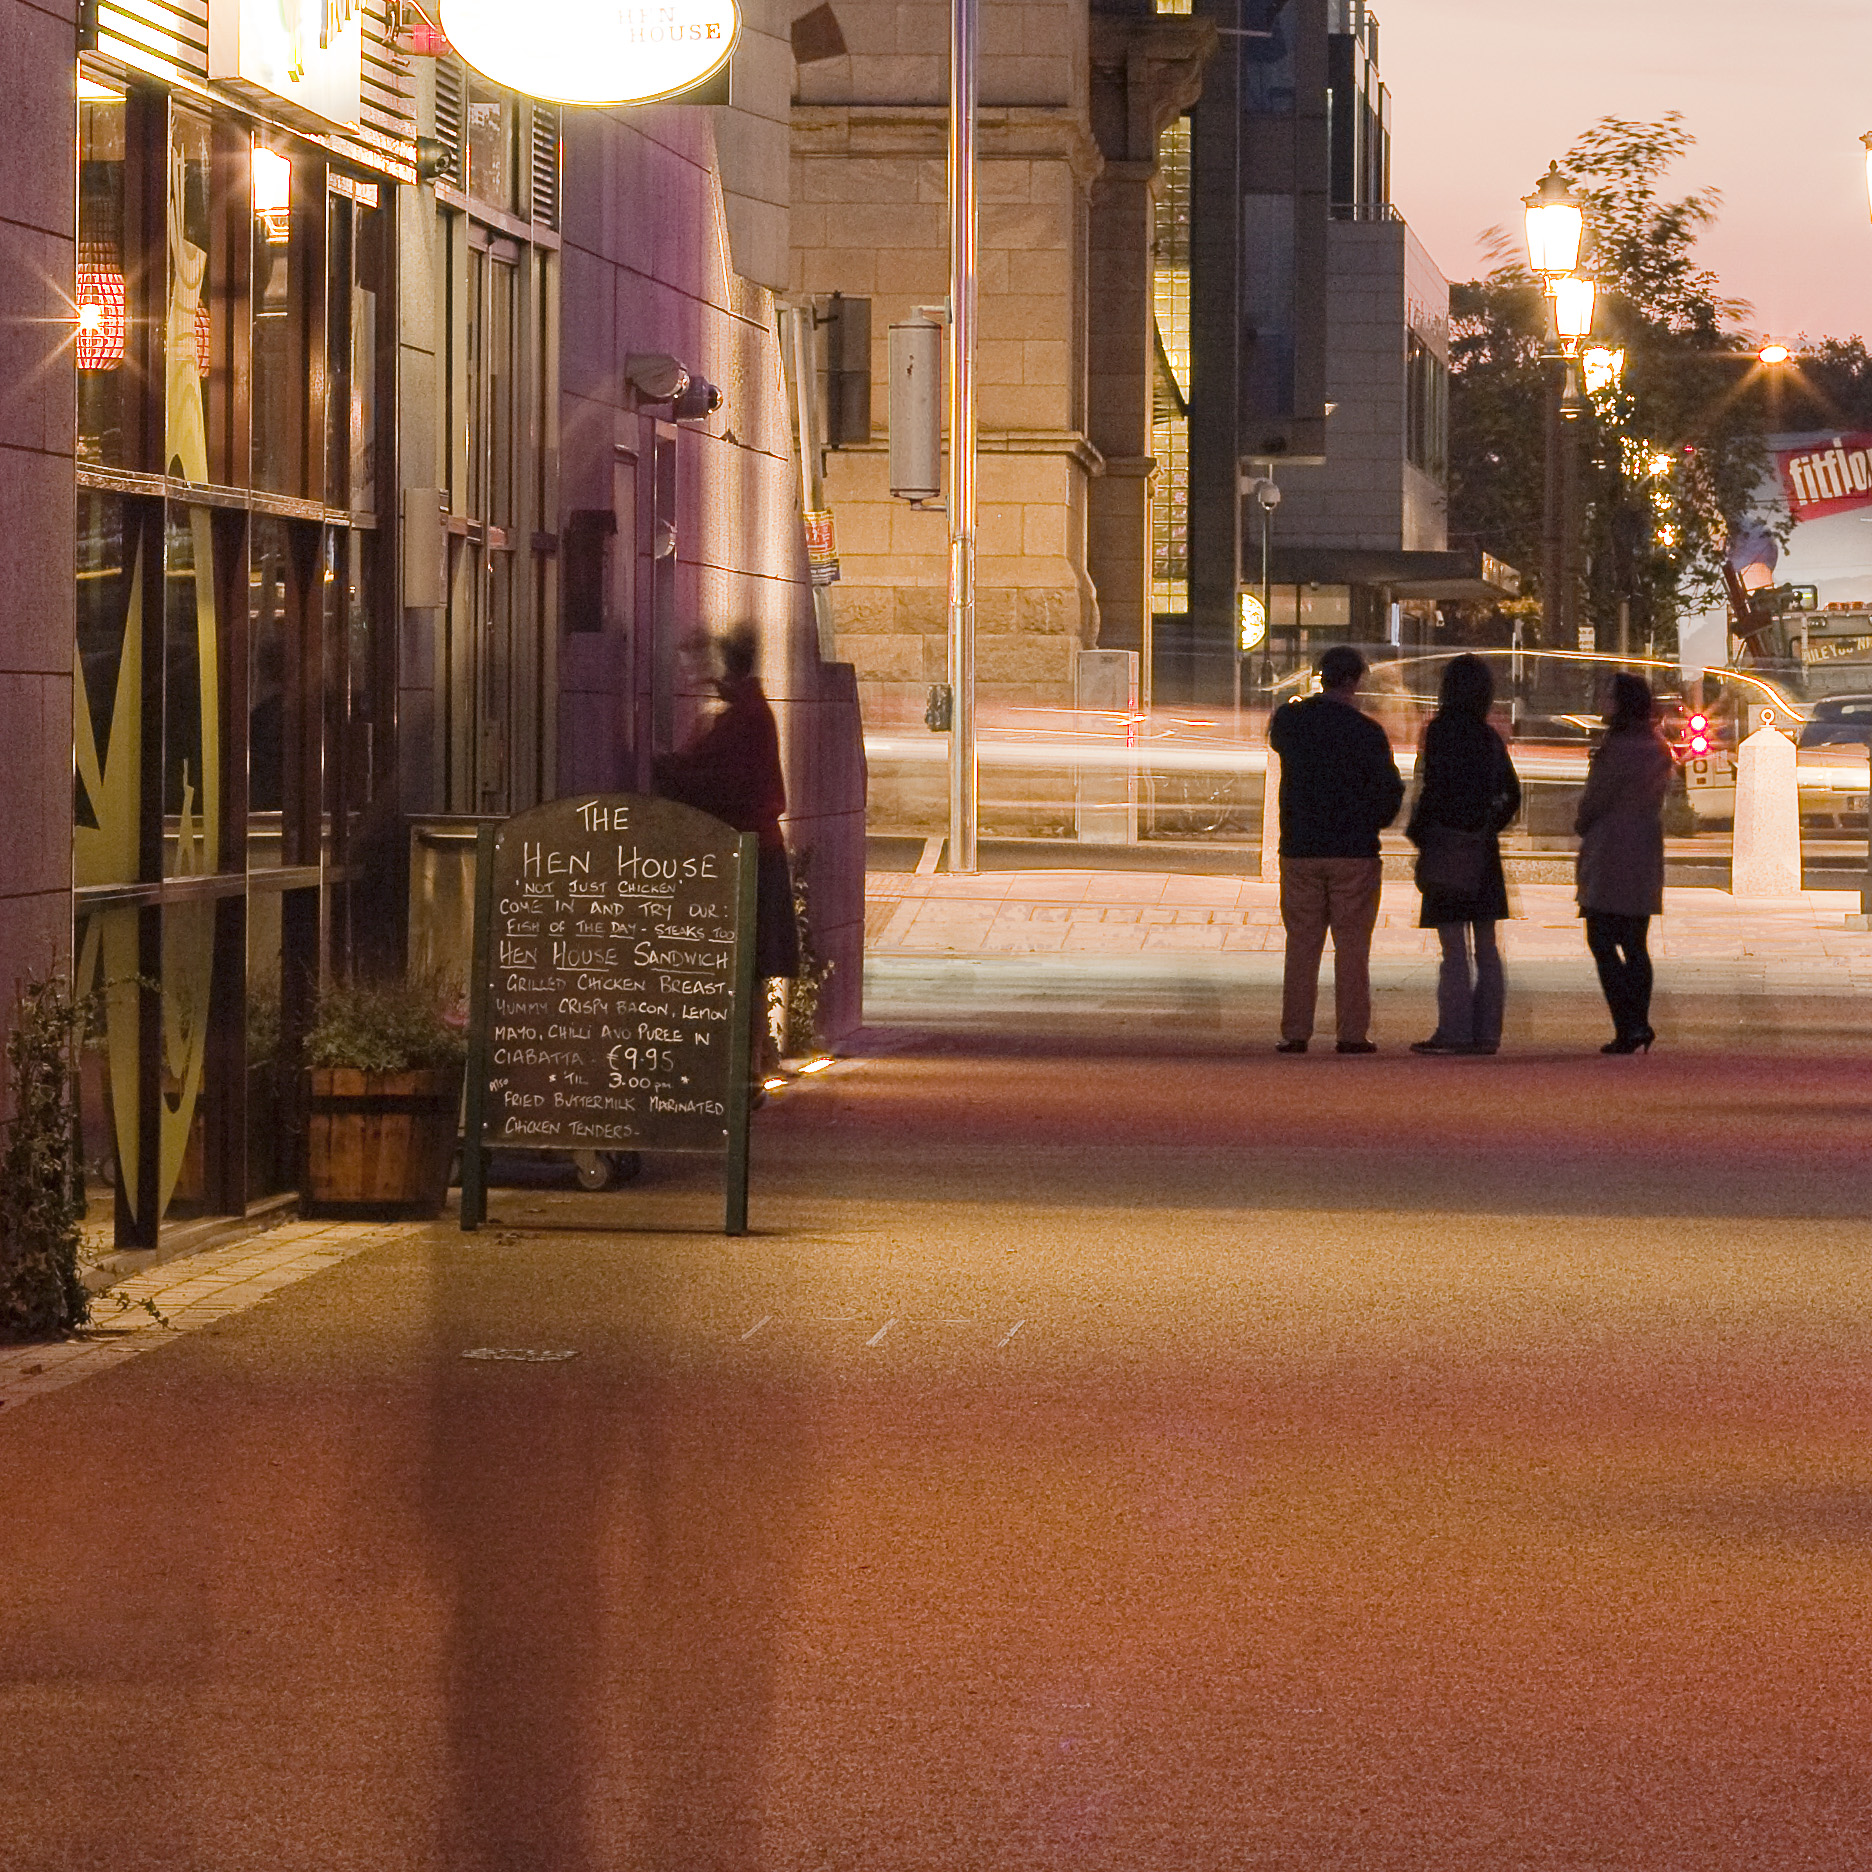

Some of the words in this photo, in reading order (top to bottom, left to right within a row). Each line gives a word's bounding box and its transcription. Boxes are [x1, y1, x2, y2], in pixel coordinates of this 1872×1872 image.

[631, 23, 721, 43] HOUSE
[576, 800, 630, 832] THE
[524, 842, 591, 878] HEN
[618, 845, 718, 879] HOUSE
[568, 879, 607, 894] JUST
[500, 899, 544, 915] COME
[555, 899, 575, 914] IN
[590, 901, 625, 916] AND
[639, 902, 672, 920] TRY
[506, 918, 540, 934] FISH
[549, 920, 565, 934] OF
[576, 919, 604, 934] THE
[610, 921, 637, 934] DAY
[654, 923, 706, 939] STEAKS
[713, 927, 735, 940] TOO
[500, 941, 537, 965] HEN
[553, 941, 619, 969] HOUSE
[634, 941, 729, 969] SANDWICH
[506, 974, 566, 992] GRILLED
[577, 974, 646, 991] CHICKEN
[660, 976, 726, 995] BREAST
[496, 999, 549, 1015] YUMMY
[558, 998, 608, 1015] CRISPY
[682, 1005, 728, 1021] LEMON
[548, 1024, 592, 1040] CHILLI
[601, 1025, 632, 1040] AVO
[638, 1023, 684, 1043] PUREE
[694, 1032, 711, 1046] IN
[494, 1048, 584, 1066] CIABATTA
[606, 1044, 674, 1072] €9.95
[609, 1072, 651, 1089] 3.00
[504, 1091, 545, 1107] FRIED
[554, 1093, 636, 1112] BUTTERMILK
[650, 1096, 724, 1116] MARINATED
[505, 1117, 561, 1135] CHICKEN
